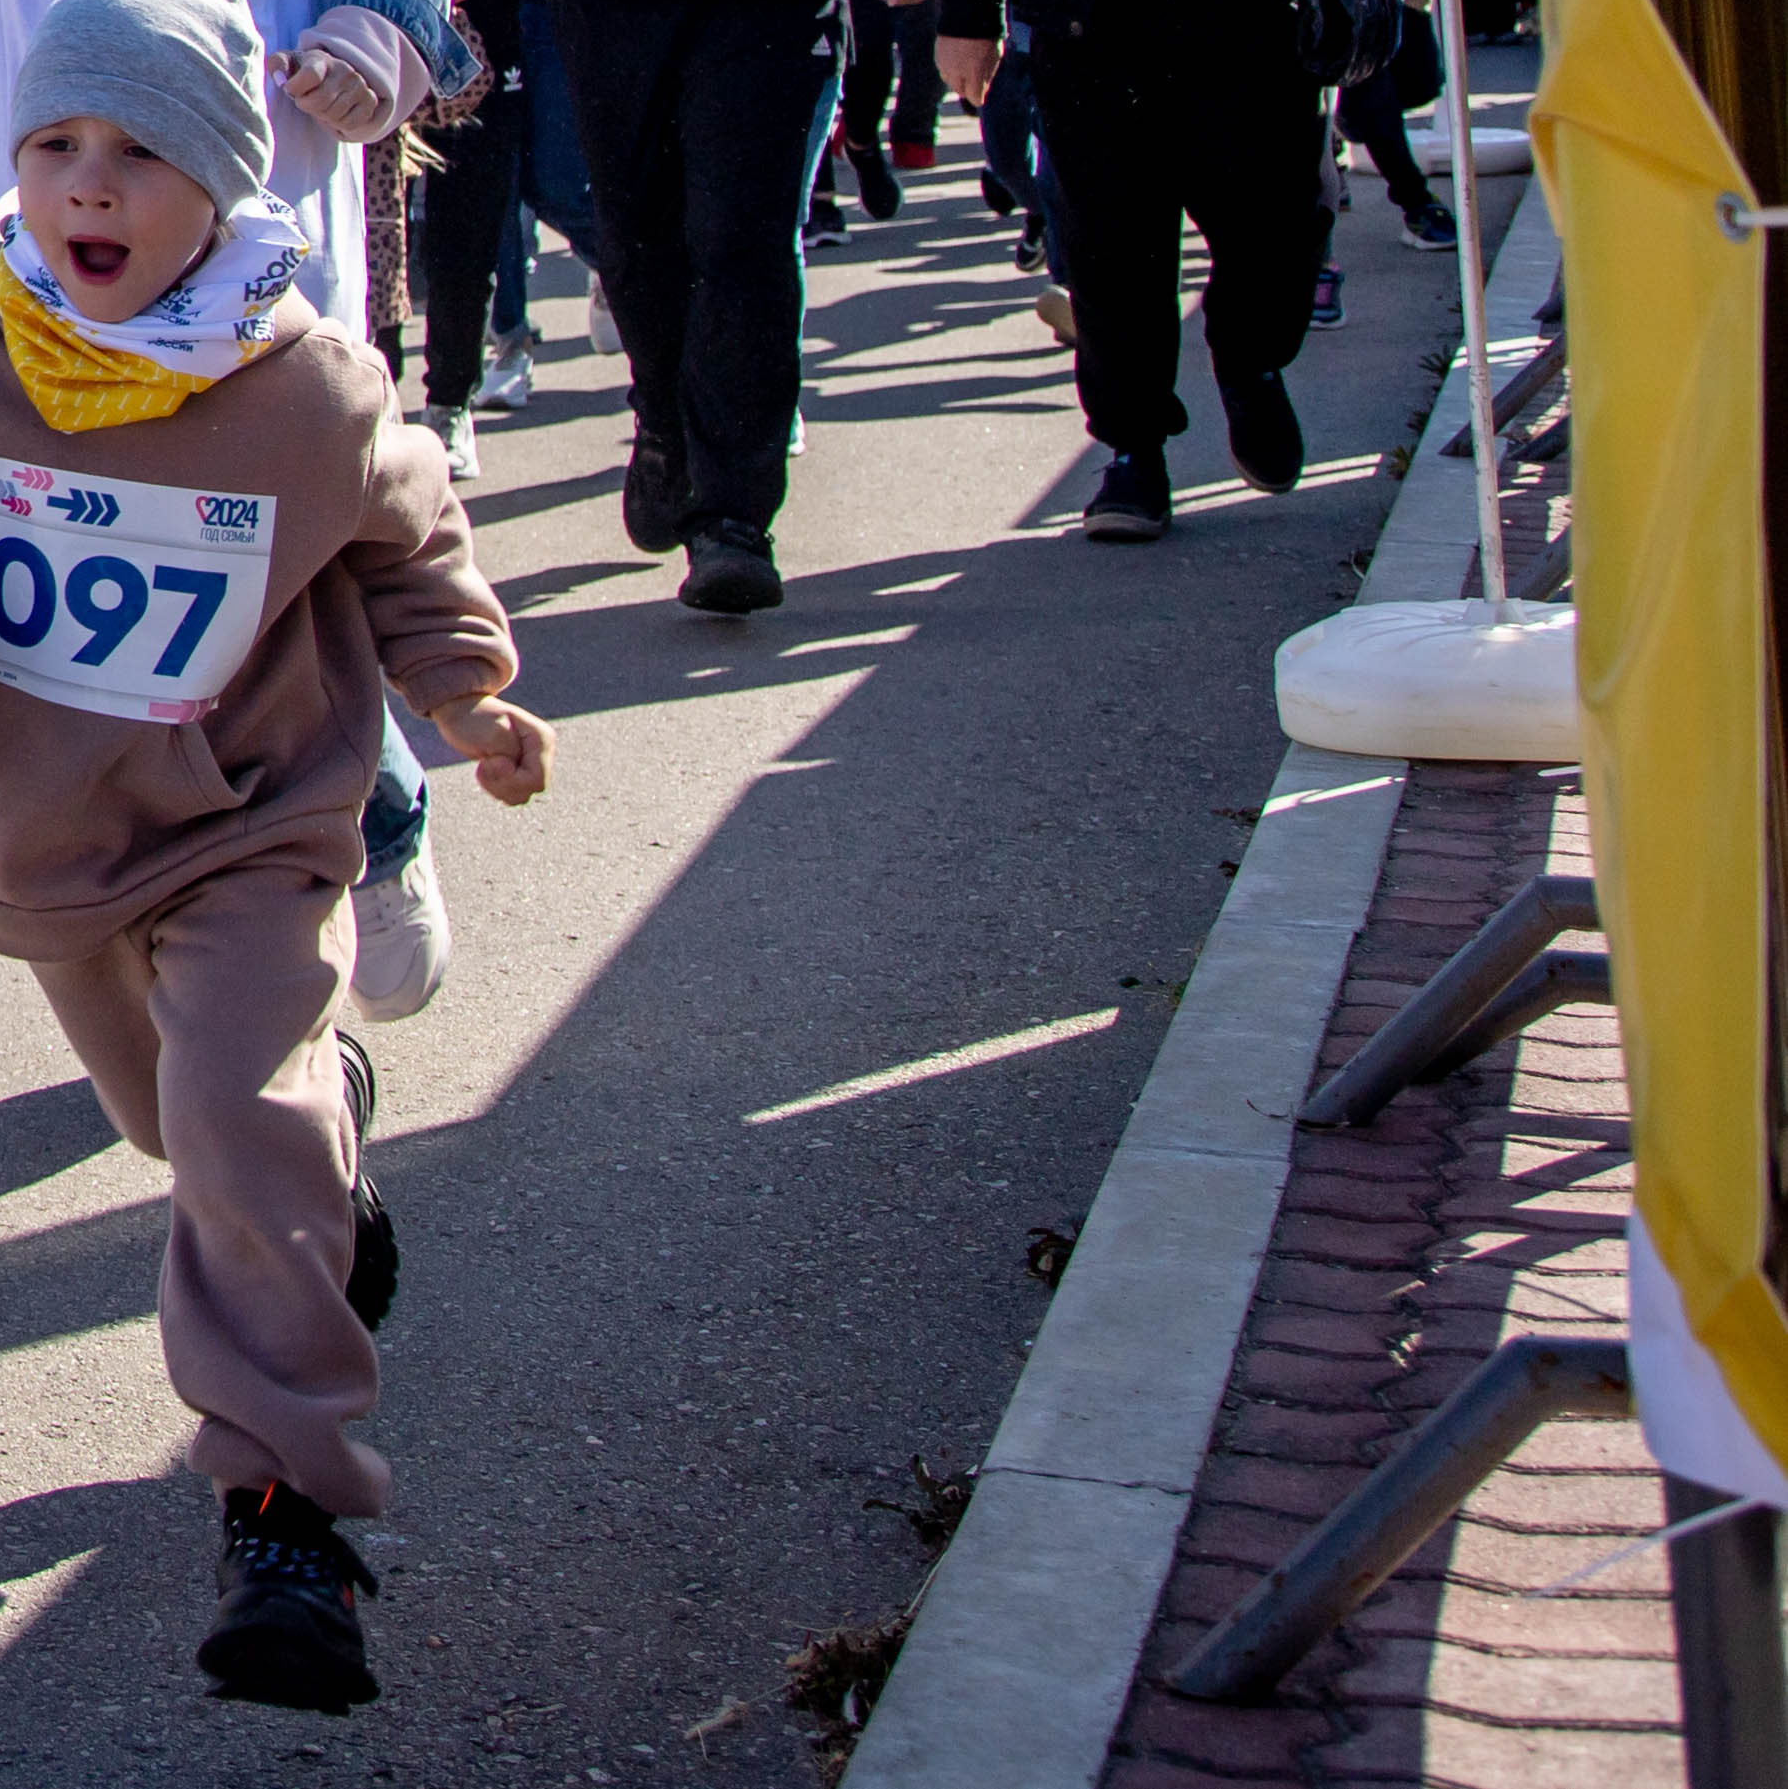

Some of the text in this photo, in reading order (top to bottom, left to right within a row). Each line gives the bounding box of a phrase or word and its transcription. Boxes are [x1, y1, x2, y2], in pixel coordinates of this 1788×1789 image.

[204, 496, 260, 529] 2024
[200, 527, 256, 543] ГОД СЕМЬИ
